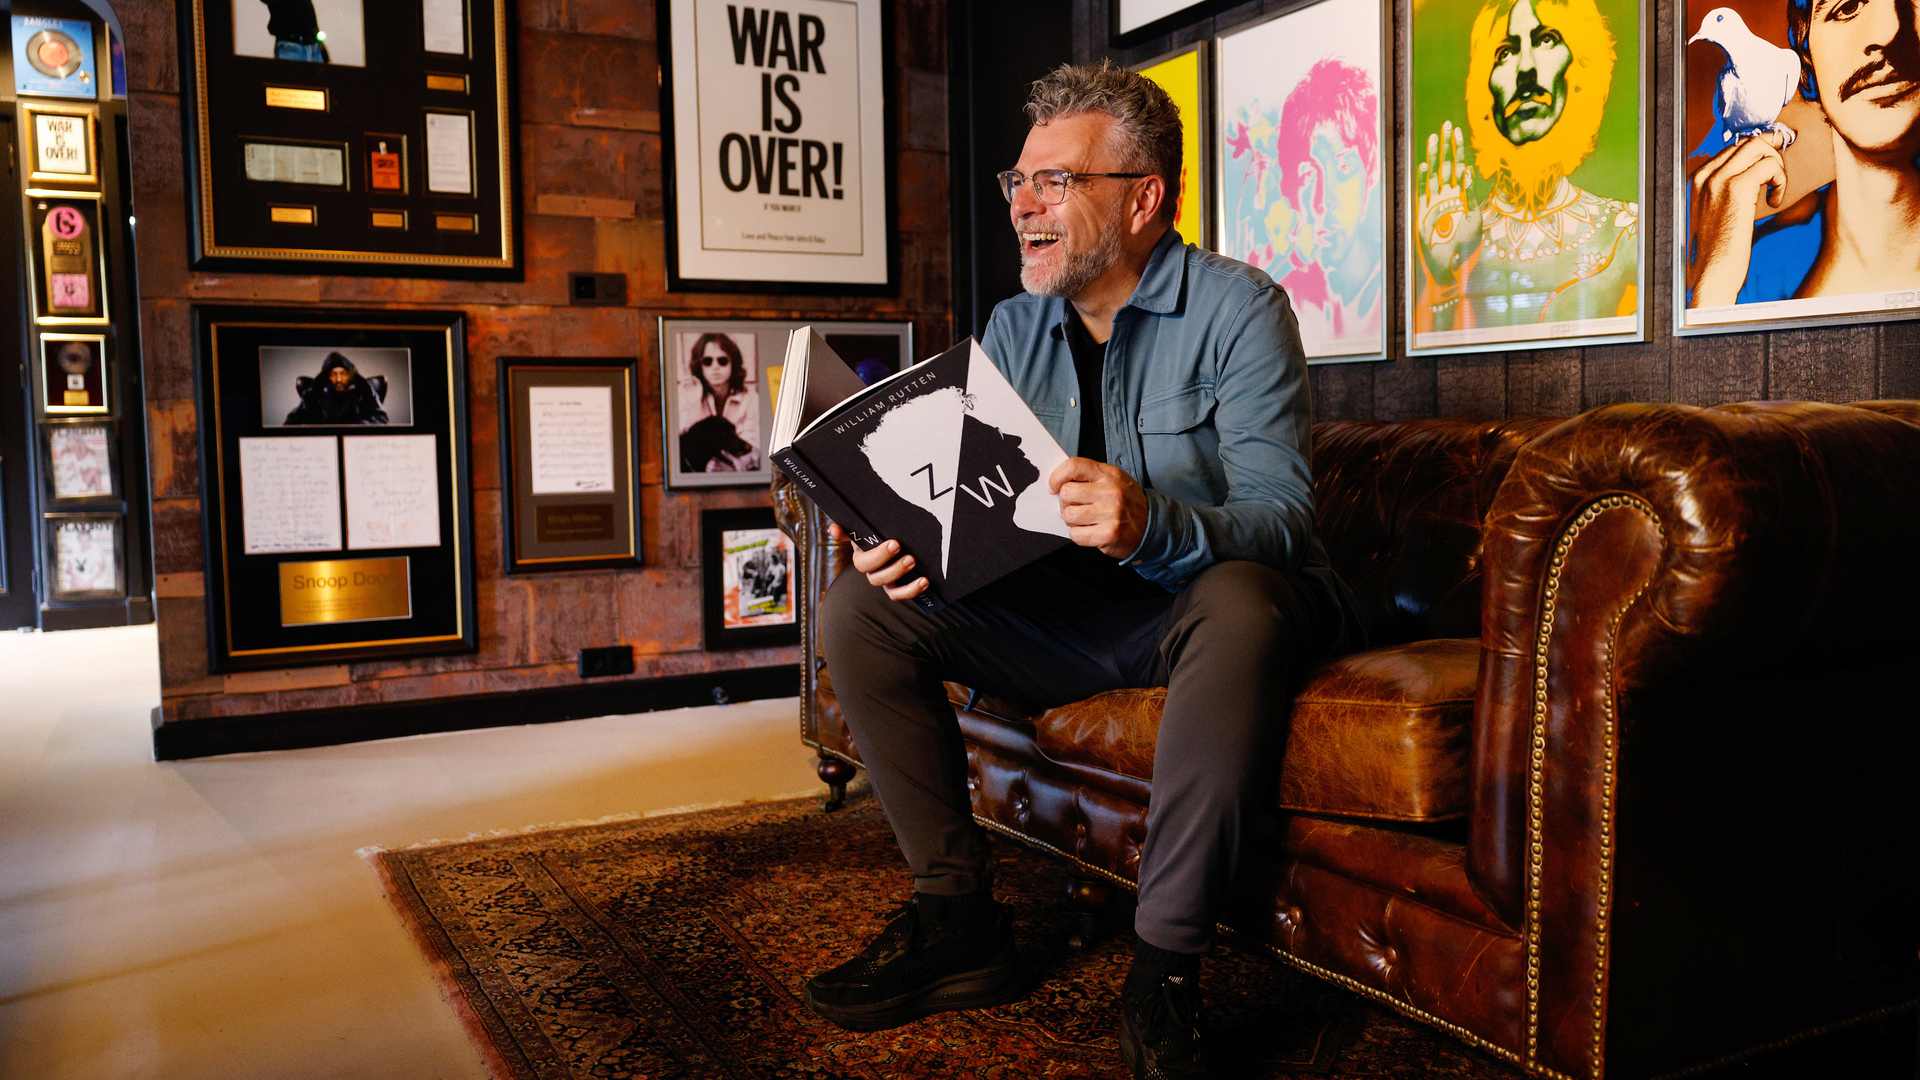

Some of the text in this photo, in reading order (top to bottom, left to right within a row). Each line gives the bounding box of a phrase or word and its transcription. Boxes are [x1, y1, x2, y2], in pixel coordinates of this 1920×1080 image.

[727, 4, 826, 74] WAR
[47, 119, 72, 132] WAR
[761, 72, 802, 134] IS
[45, 146, 78, 160] OVER!
[719, 132, 844, 200] OVER!
[834, 371, 936, 434] WILLIAM RUTTEN
[783, 457, 816, 489] WILLIAM
[293, 571, 393, 590] Snoop Dog
